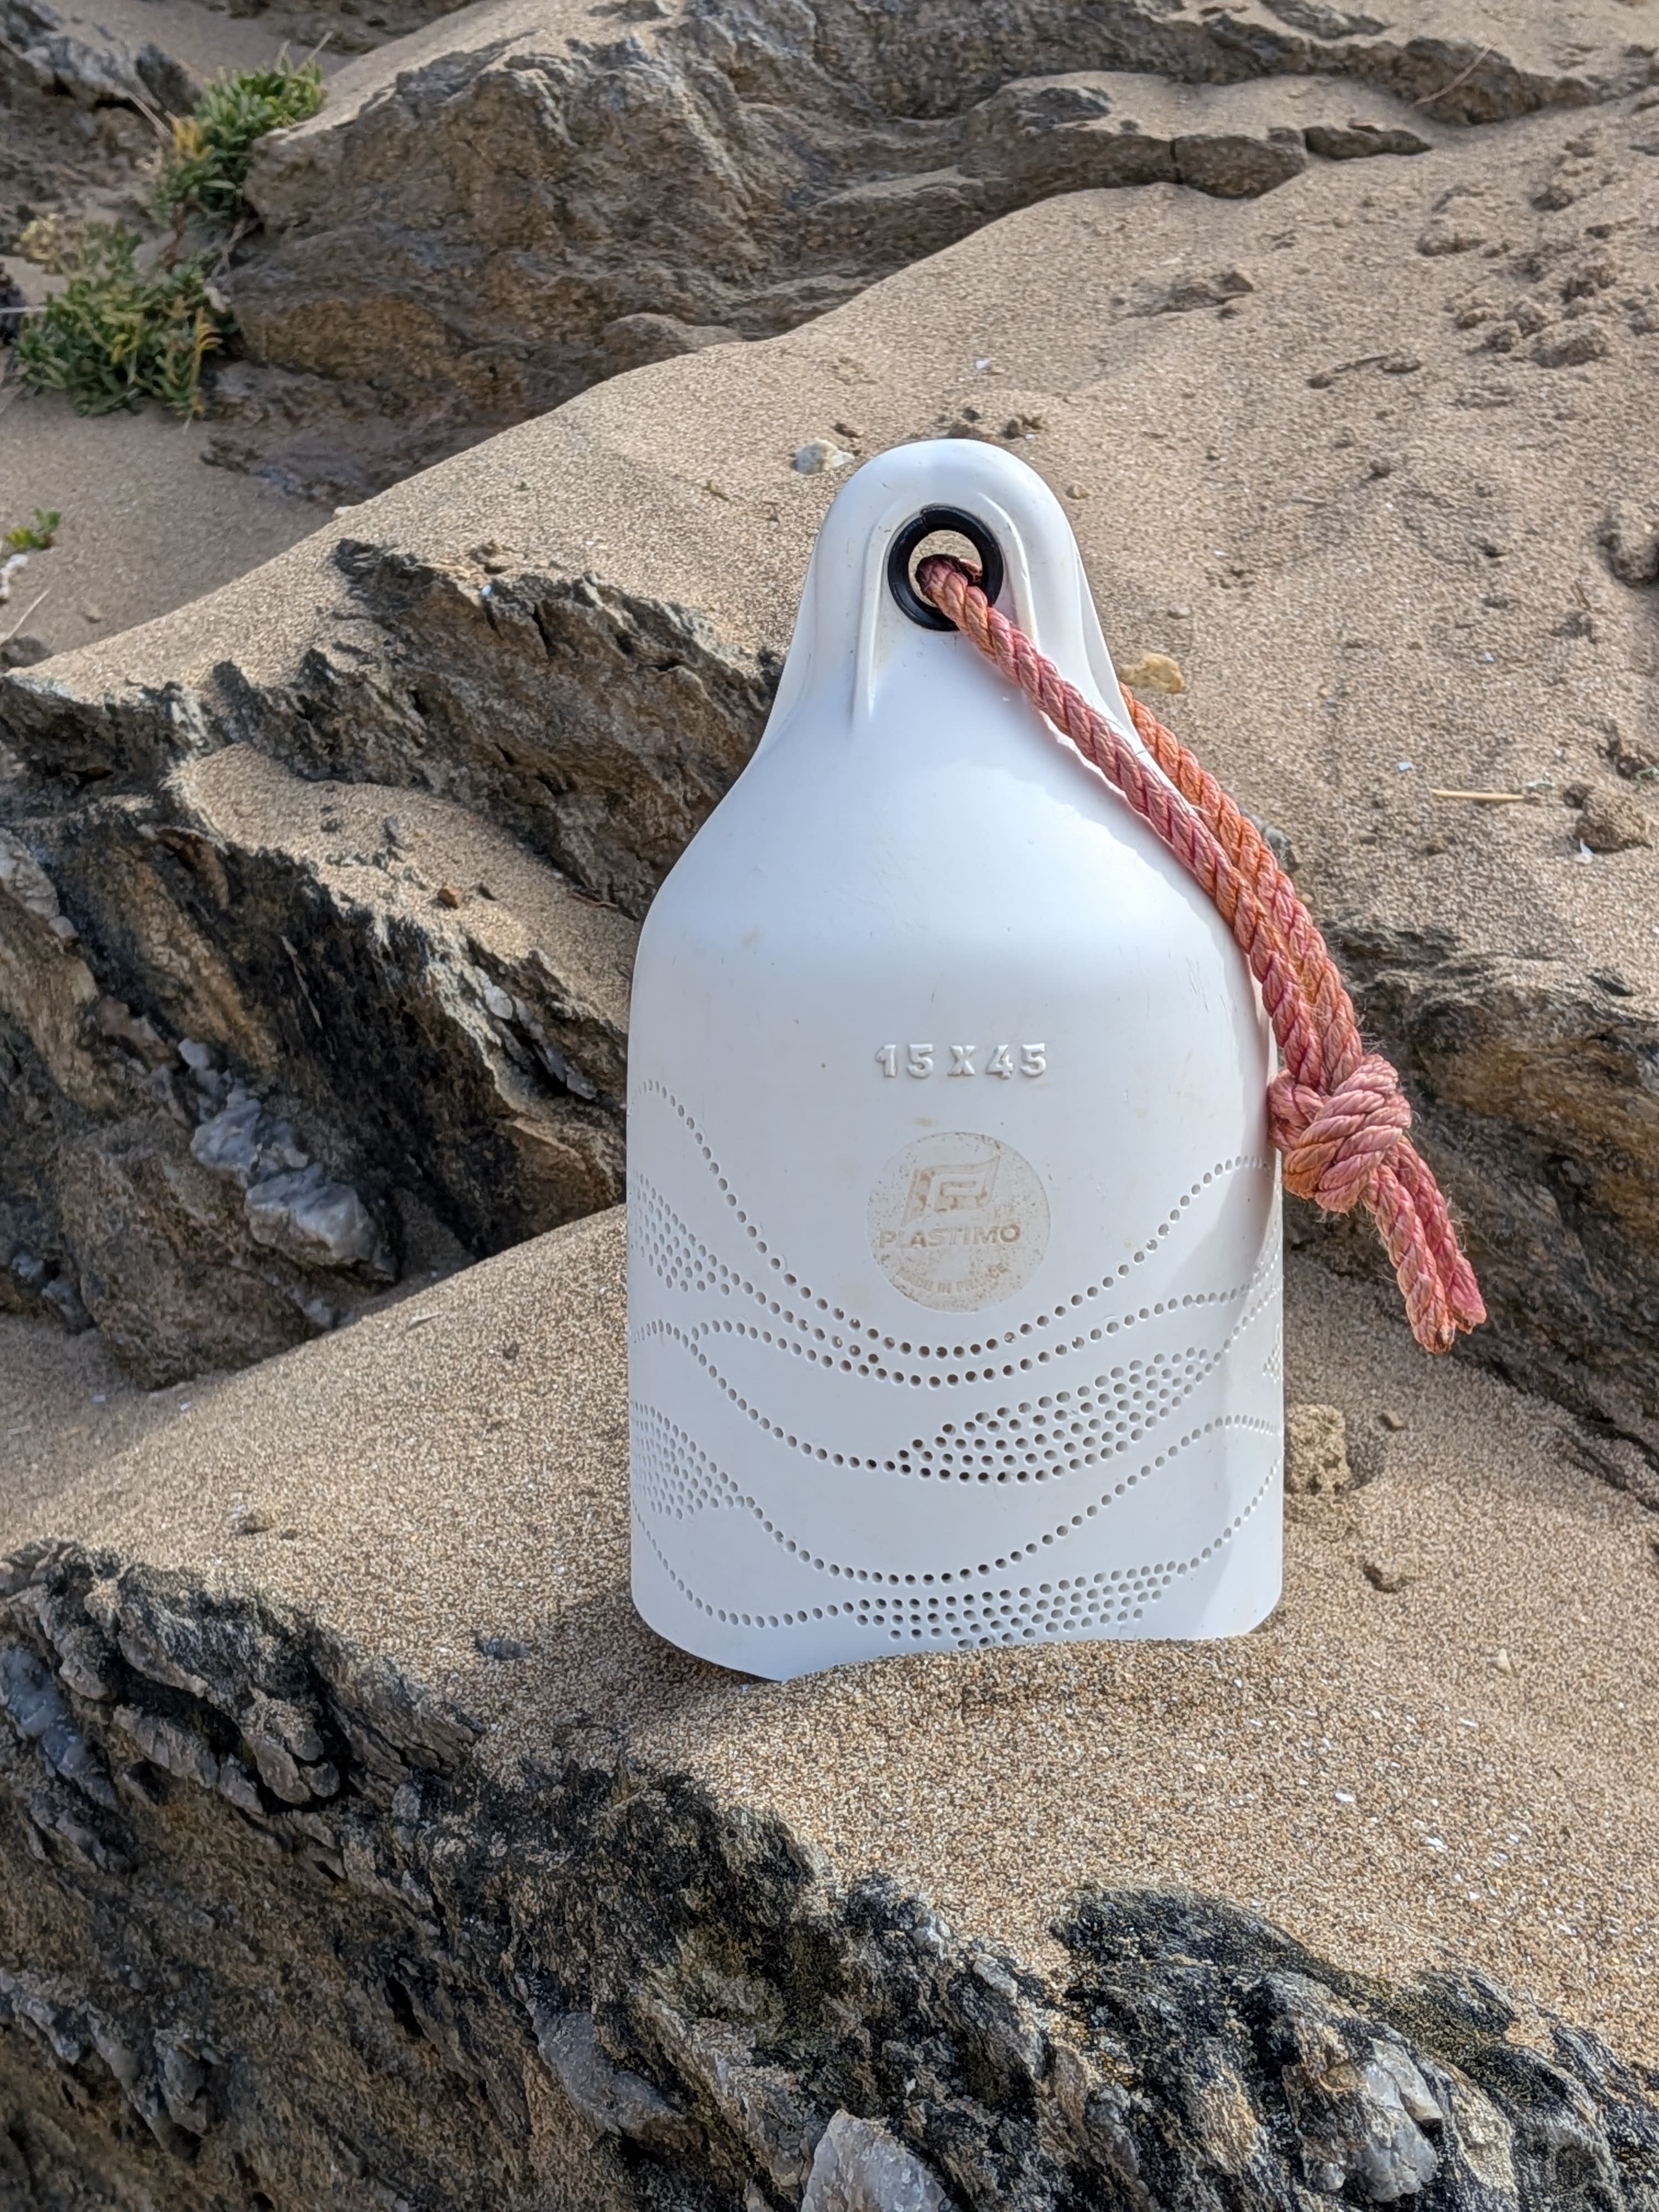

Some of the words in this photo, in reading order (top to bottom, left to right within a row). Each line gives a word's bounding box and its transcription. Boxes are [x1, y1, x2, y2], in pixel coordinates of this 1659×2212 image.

[875, 1044, 934, 1079] 15
[986, 1043, 1046, 1080] 45
[879, 1222, 1021, 1249] PLASTIMO
